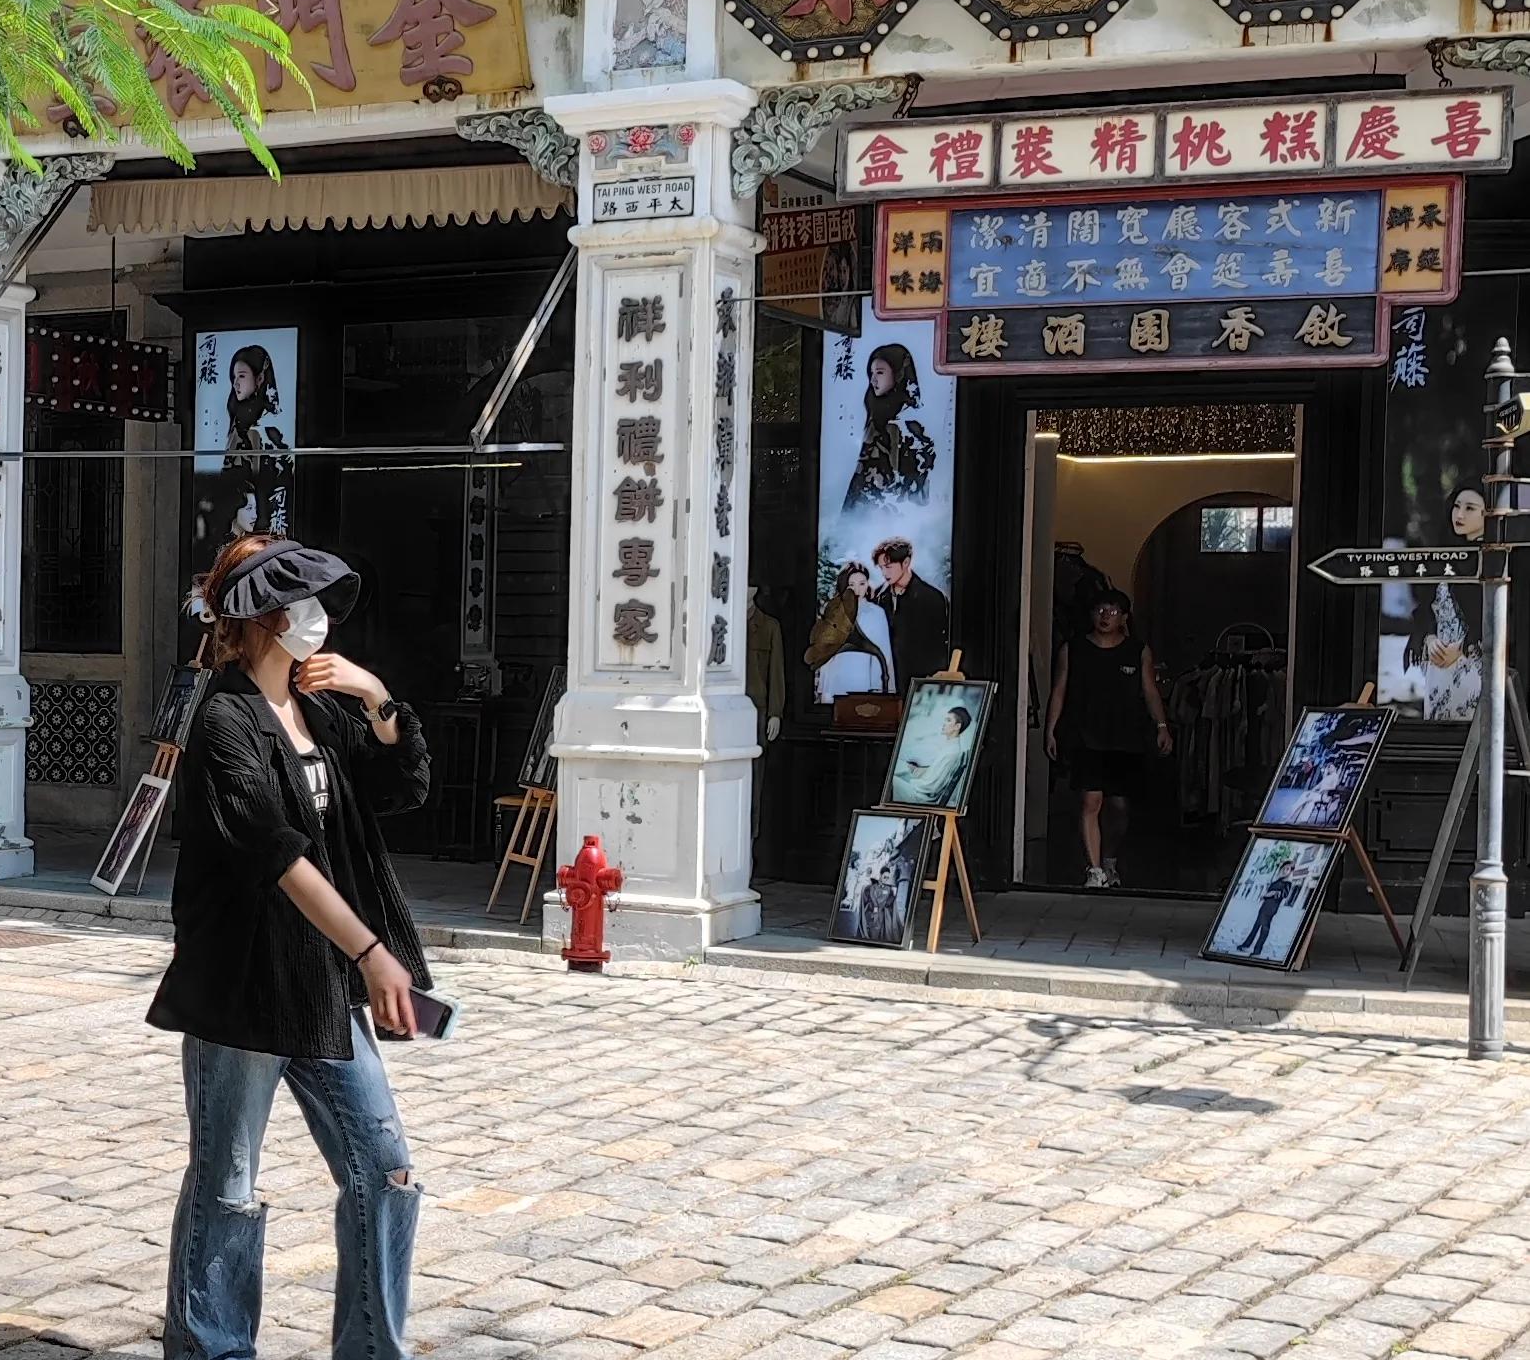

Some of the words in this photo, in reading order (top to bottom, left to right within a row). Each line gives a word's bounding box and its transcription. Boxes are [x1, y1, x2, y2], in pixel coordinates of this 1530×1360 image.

[597, 189, 611, 198] TAI
[613, 186, 635, 197] PING
[637, 183, 662, 195] WEST
[665, 181, 690, 193] ROAD
[601, 196, 685, 216] 太平西路
[612, 294, 667, 647] 祥利禮餅專家
[1347, 553, 1362, 562] TY
[1365, 553, 1395, 562] PING
[1396, 552, 1431, 562] WEST
[1432, 551, 1468, 561] ROAD
[1360, 563, 1456, 578] 太平西路
